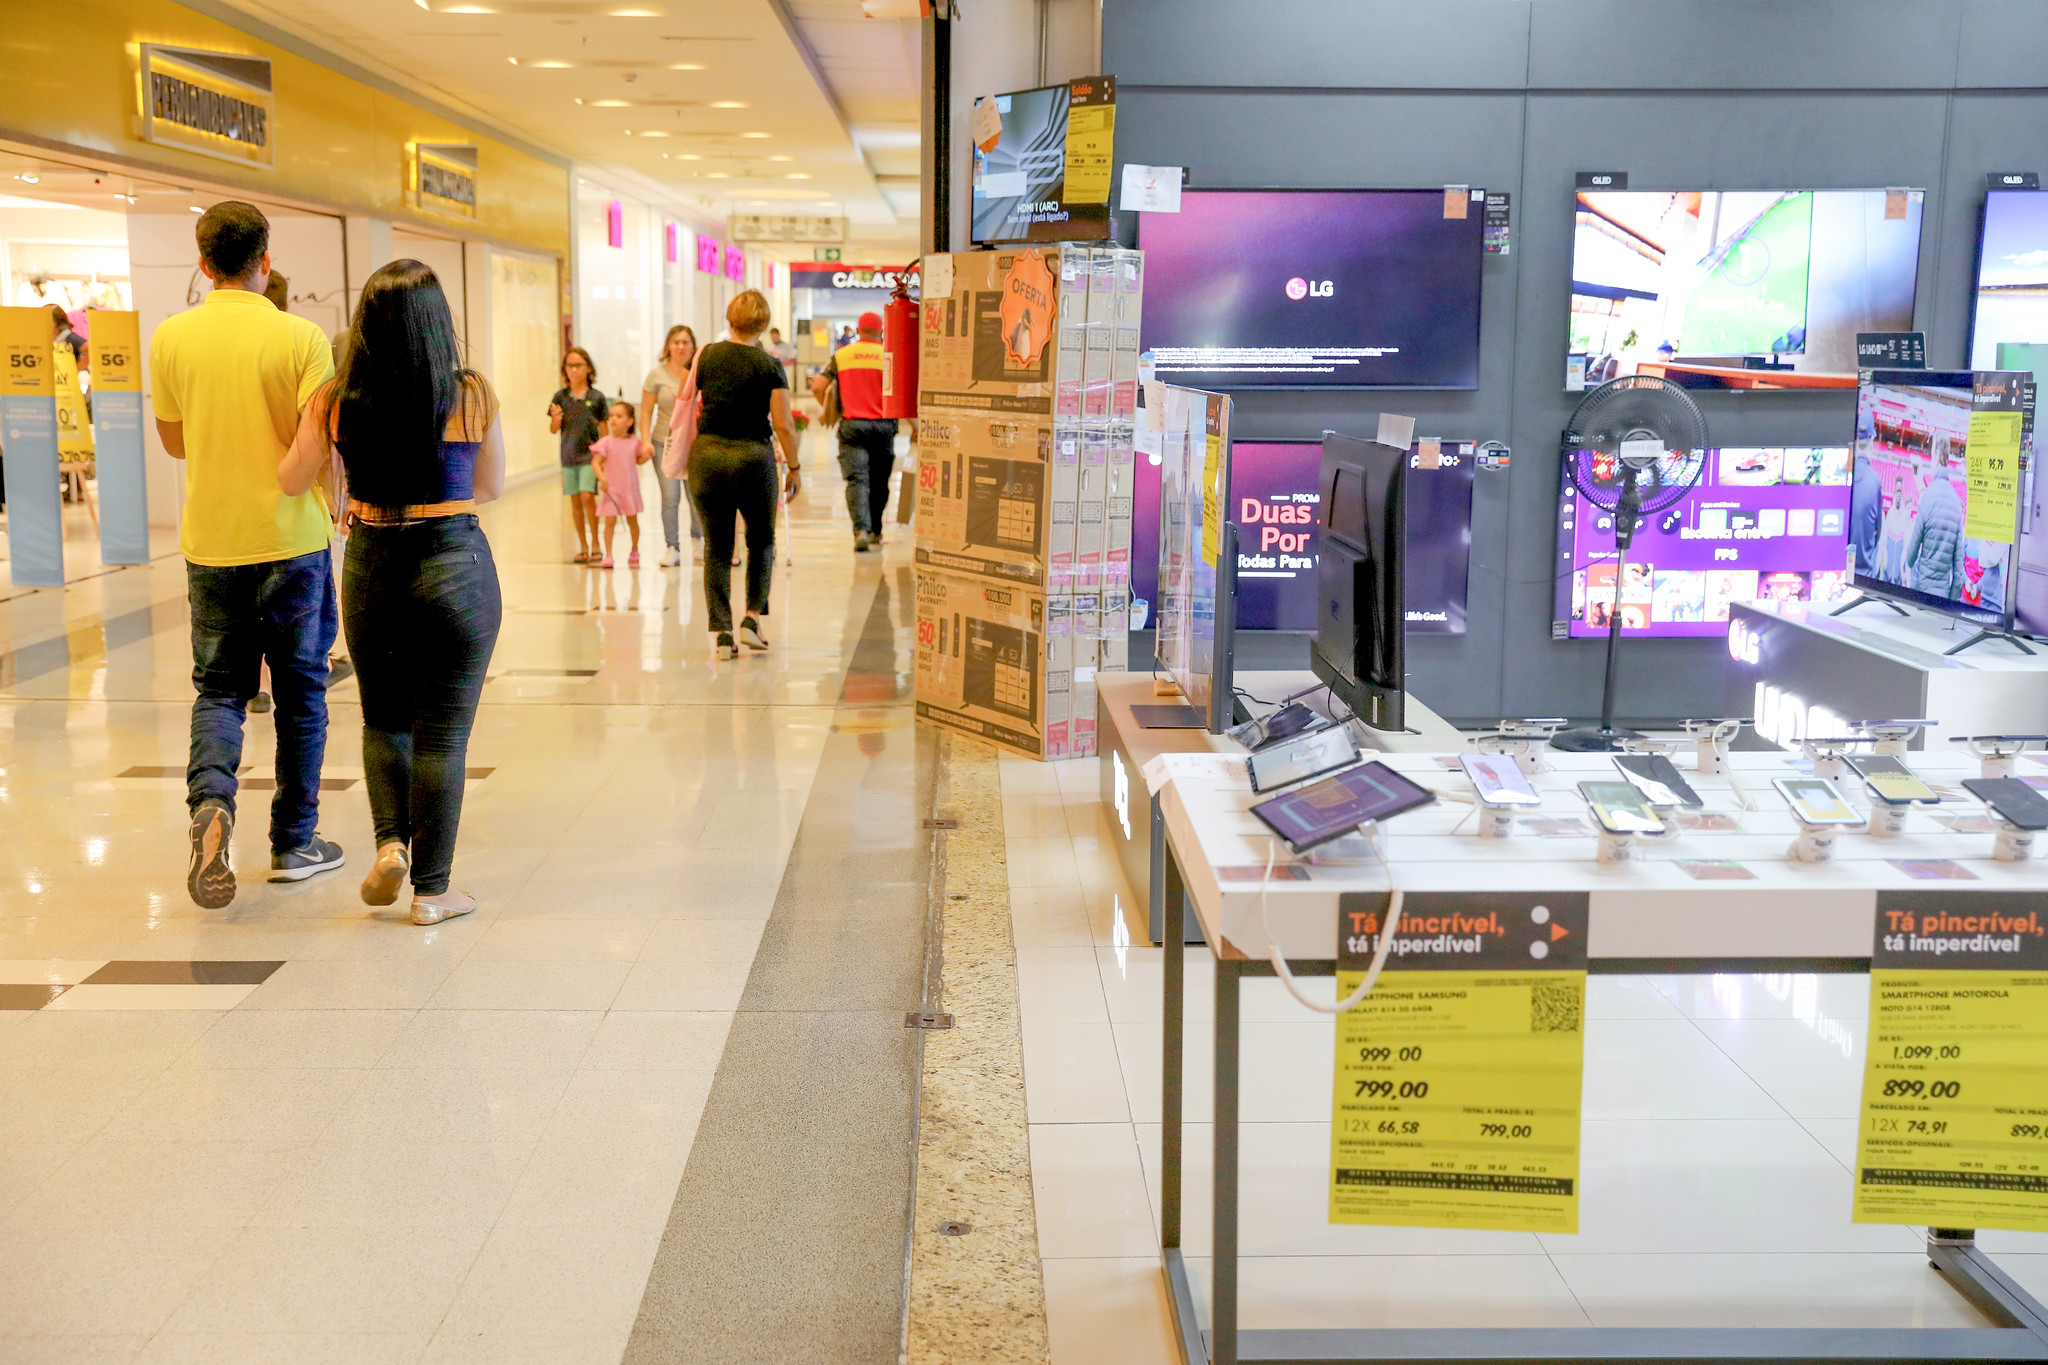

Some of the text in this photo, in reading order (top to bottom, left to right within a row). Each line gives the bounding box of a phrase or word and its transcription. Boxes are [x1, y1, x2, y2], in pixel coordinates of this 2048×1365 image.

[151, 71, 266, 147] PERNAMBUCANAS
[1039, 201, 1059, 213] (ARC)
[1012, 279, 1047, 311] OFERTA
[1310, 280, 1334, 297] LG
[920, 420, 950, 440] Philco
[1241, 498, 1312, 525] Duas
[1261, 527, 1311, 552] Por
[1280, 555, 1312, 569] Para
[917, 575, 947, 598] Philco
[1347, 911, 1505, 937] Tá incrível,
[1886, 911, 2044, 937] Tá pincrível,
[1347, 935, 1369, 954] tá
[1884, 934, 2021, 955] tá imperdível
[1417, 991, 1467, 1000] SAMSUNG
[1881, 990, 2010, 999] SMARTPHONE MOTOROLA
[1360, 1046, 1422, 1062] 999,00
[1893, 1045, 1961, 1061] 1.099,00
[1354, 1080, 1429, 1100] 799,00
[1882, 1079, 1961, 1100] 899,00
[1343, 1119, 1420, 1135] 12X 66,58
[1480, 1124, 1532, 1139] 799,00
[1871, 1118, 1948, 1135] 12X 74,91
[1385, 1171, 1432, 1179] EXCLUSIVA
[1509, 1176, 1557, 1185] TELEFONIA
[1912, 1170, 1960, 1178] EXCLUSIVA
[1390, 1180, 1448, 1188] OPERADORAS
[1460, 1183, 1495, 1191] PLANOS
[1499, 1185, 1565, 1194] PARTICIPANTES
[1866, 1178, 1912, 1186] CONSULTE
[1917, 1180, 1976, 1188] OPERADORAS
[1989, 1183, 2024, 1191] PLANOS
